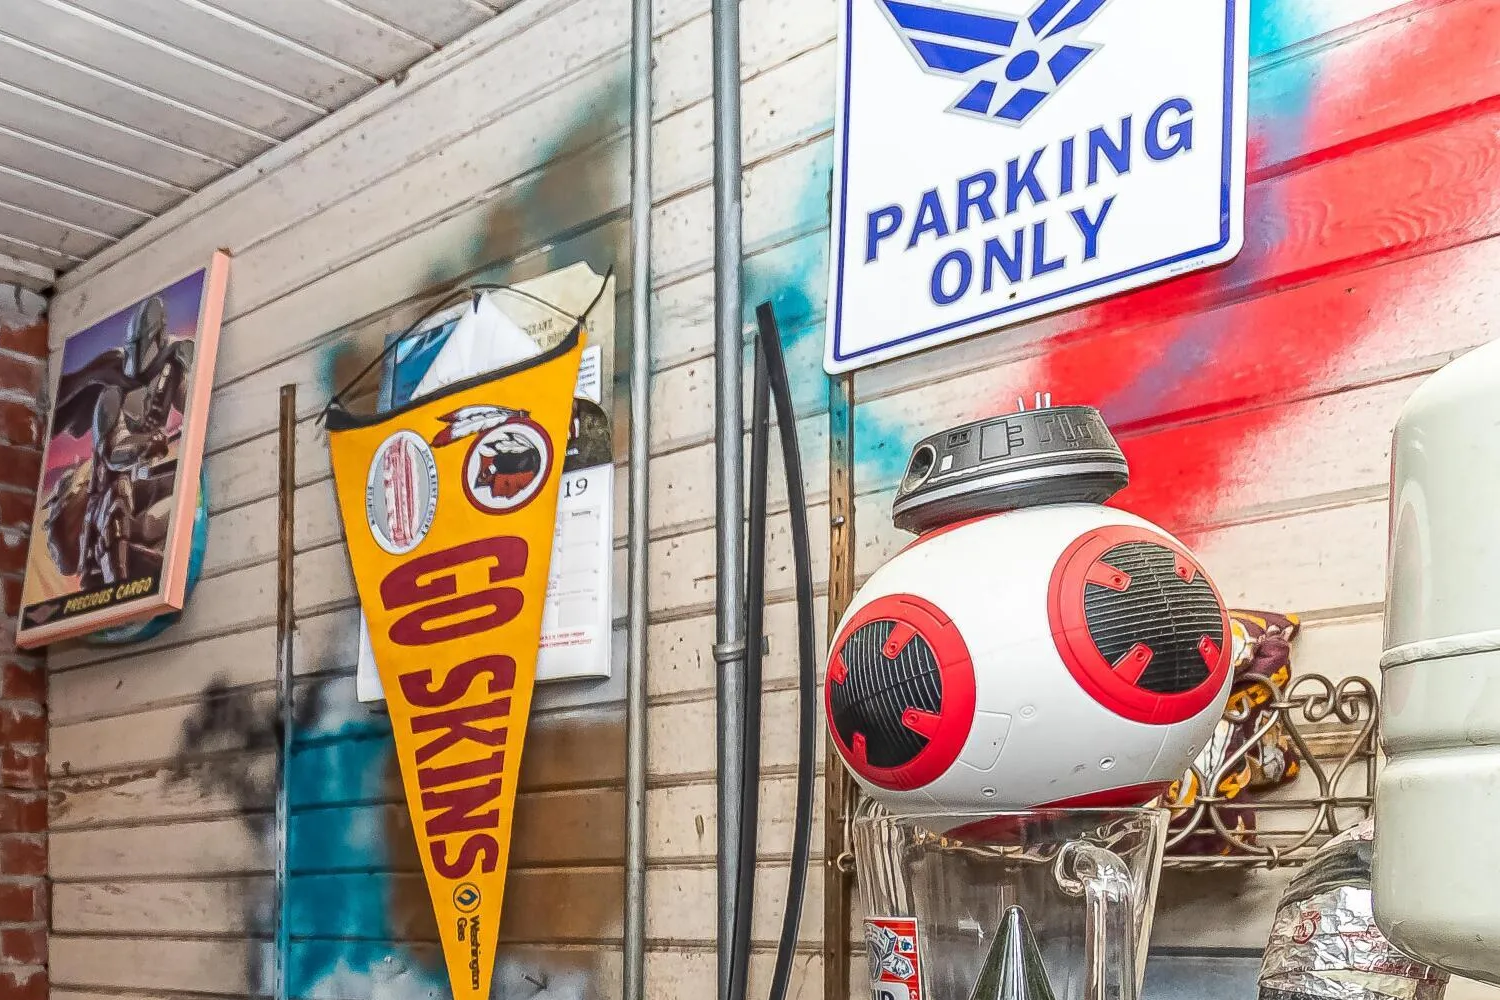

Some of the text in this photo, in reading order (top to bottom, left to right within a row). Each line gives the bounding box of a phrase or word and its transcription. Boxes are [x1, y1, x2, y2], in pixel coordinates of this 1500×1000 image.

[864, 97, 1195, 264] PARKING
[930, 194, 1117, 306] ONLY
[64, 577, 152, 613] PRECIOUS CARGO
[379, 535, 529, 881] GO SKINS
[457, 917, 467, 941] Gas
[469, 914, 481, 990] Washington
